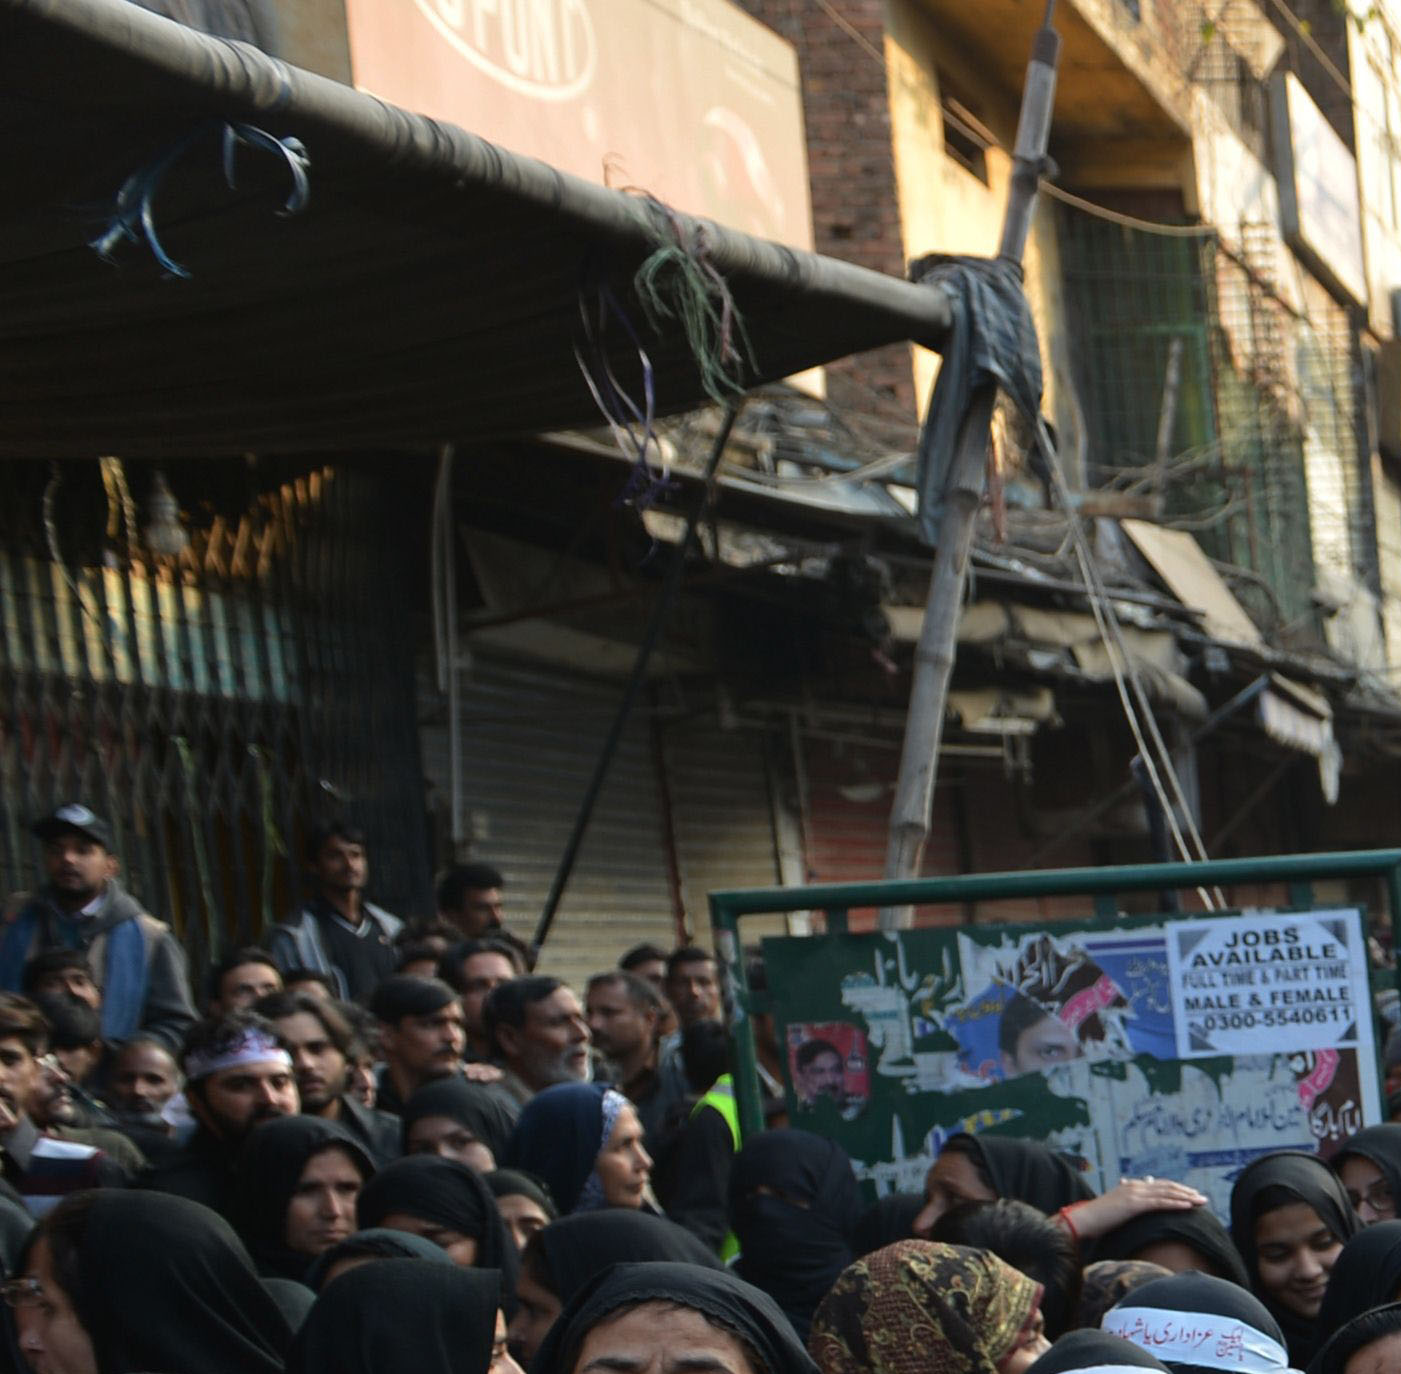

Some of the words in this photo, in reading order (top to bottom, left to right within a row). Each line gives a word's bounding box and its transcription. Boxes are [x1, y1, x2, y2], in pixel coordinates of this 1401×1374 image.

[1225, 927, 1300, 948] JOBS
[1192, 943, 1338, 968] AVAILABLE
[1182, 970, 1217, 989] FULL
[1222, 969, 1254, 987] TIME
[1260, 968, 1271, 985] &
[1274, 966, 1309, 983] PART
[1316, 964, 1347, 980] TIME
[1184, 993, 1241, 1011] MALE
[1248, 991, 1262, 1007] &
[1270, 986, 1350, 1006] FEMALE
[1204, 1006, 1351, 1031] 0300-5540611
